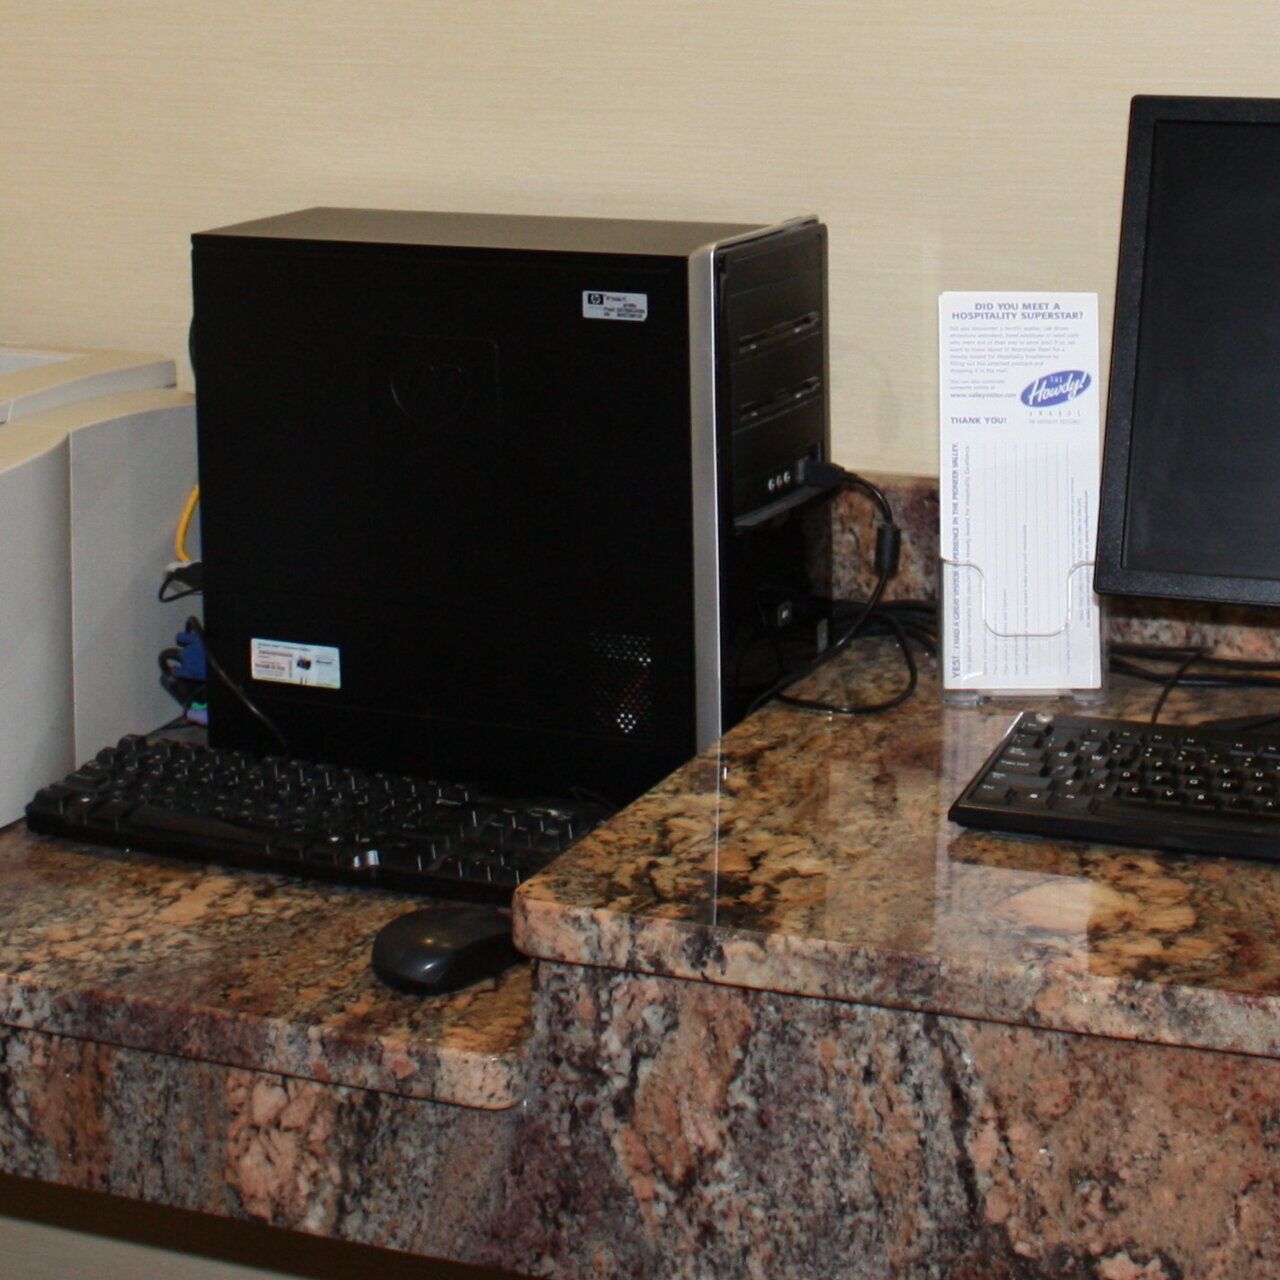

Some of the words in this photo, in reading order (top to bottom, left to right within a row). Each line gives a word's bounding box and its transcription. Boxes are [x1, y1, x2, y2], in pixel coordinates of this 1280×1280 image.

[974, 302, 994, 310] DID
[997, 302, 1019, 310] YOU
[1022, 302, 1050, 310] MEET
[1053, 302, 1061, 310] A
[951, 311, 1017, 320] HOSPITALITY
[1020, 311, 1084, 320] SUPERSTAR?
[1028, 371, 1088, 406] Howdy!
[950, 416, 981, 424] THANK
[984, 416, 1007, 424] YOU!
[952, 598, 960, 621] GREAT
[951, 655, 961, 679] YES!
